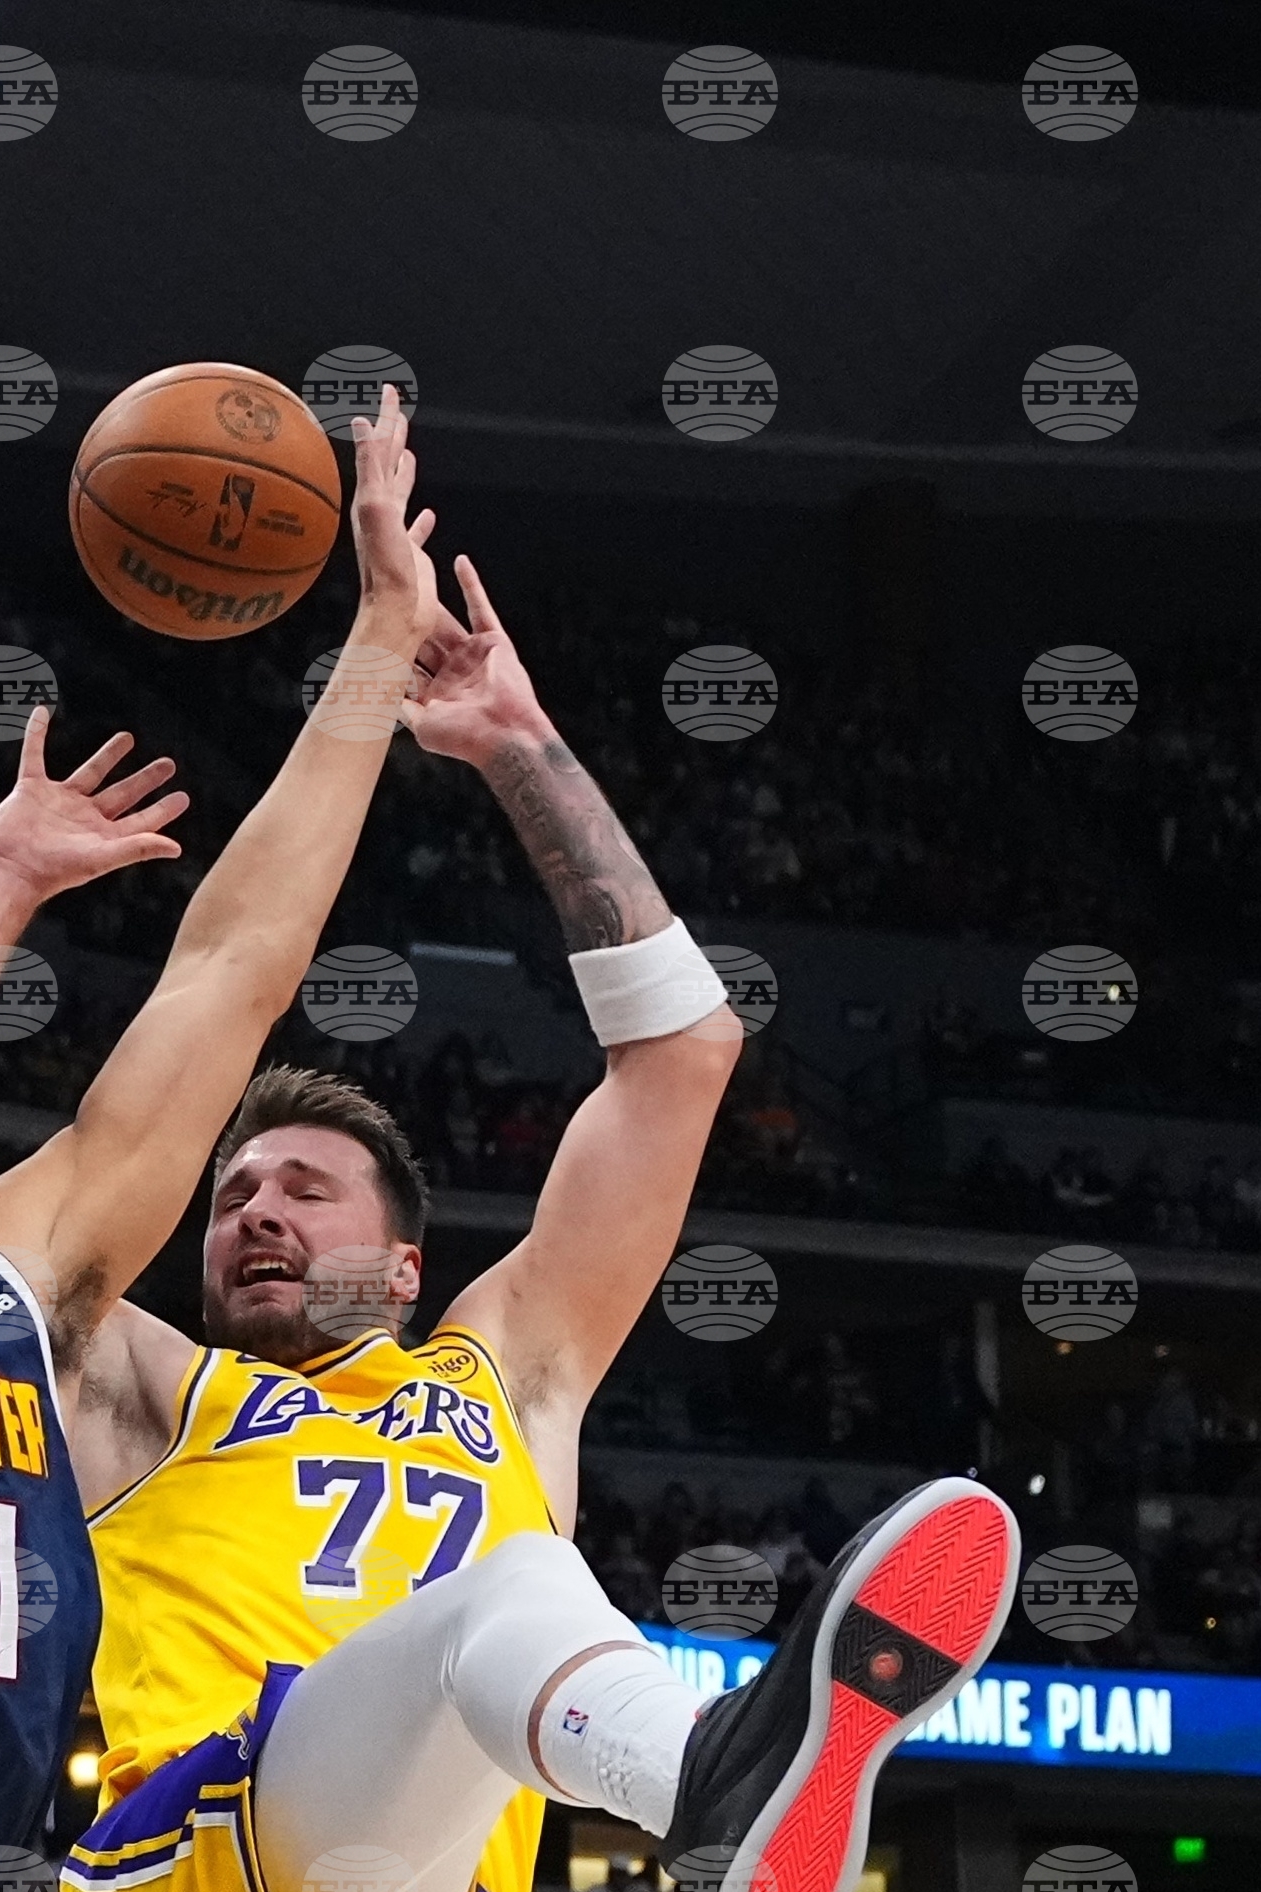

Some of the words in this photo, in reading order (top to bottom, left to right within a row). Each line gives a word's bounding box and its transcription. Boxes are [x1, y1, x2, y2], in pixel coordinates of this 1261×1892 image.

[210, 1372, 501, 1464] LAERS
[294, 1456, 488, 1599] 77
[1047, 1682, 1172, 1755] PLAN
